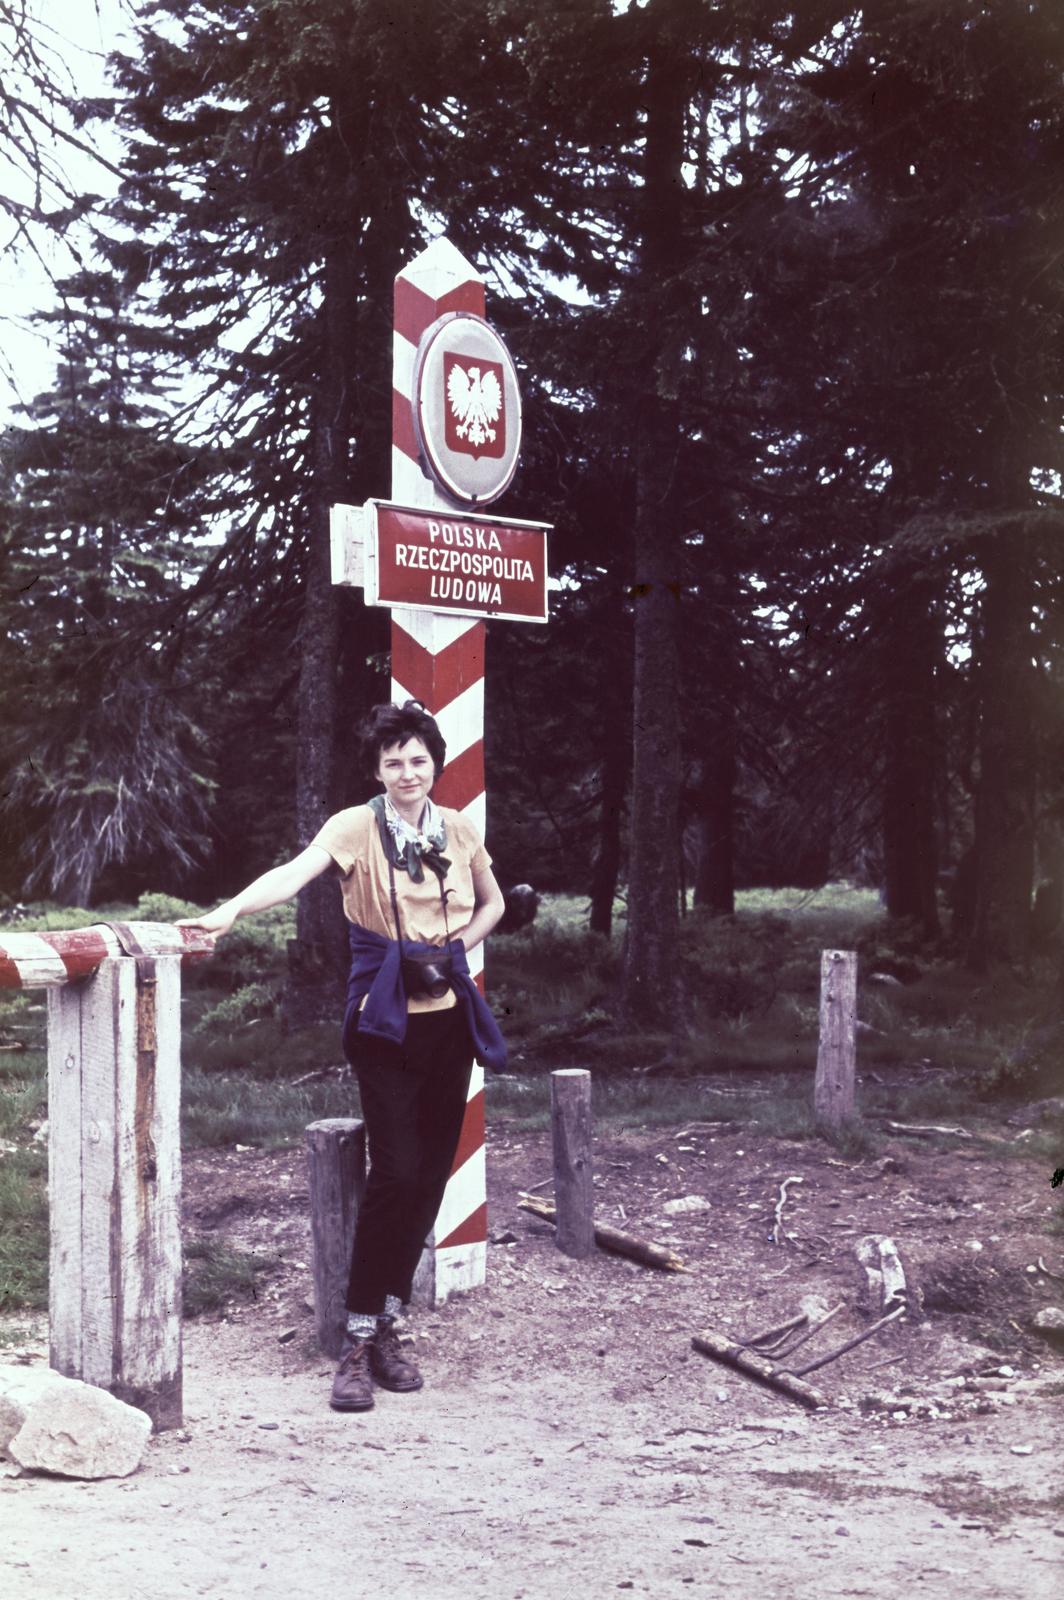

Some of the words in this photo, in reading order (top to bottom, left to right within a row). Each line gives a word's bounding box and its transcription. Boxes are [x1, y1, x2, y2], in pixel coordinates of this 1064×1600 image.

[428, 521, 502, 551] POLSKA
[395, 543, 534, 582] RZECZPOSPOLITA
[430, 575, 502, 605] LUDOWA
